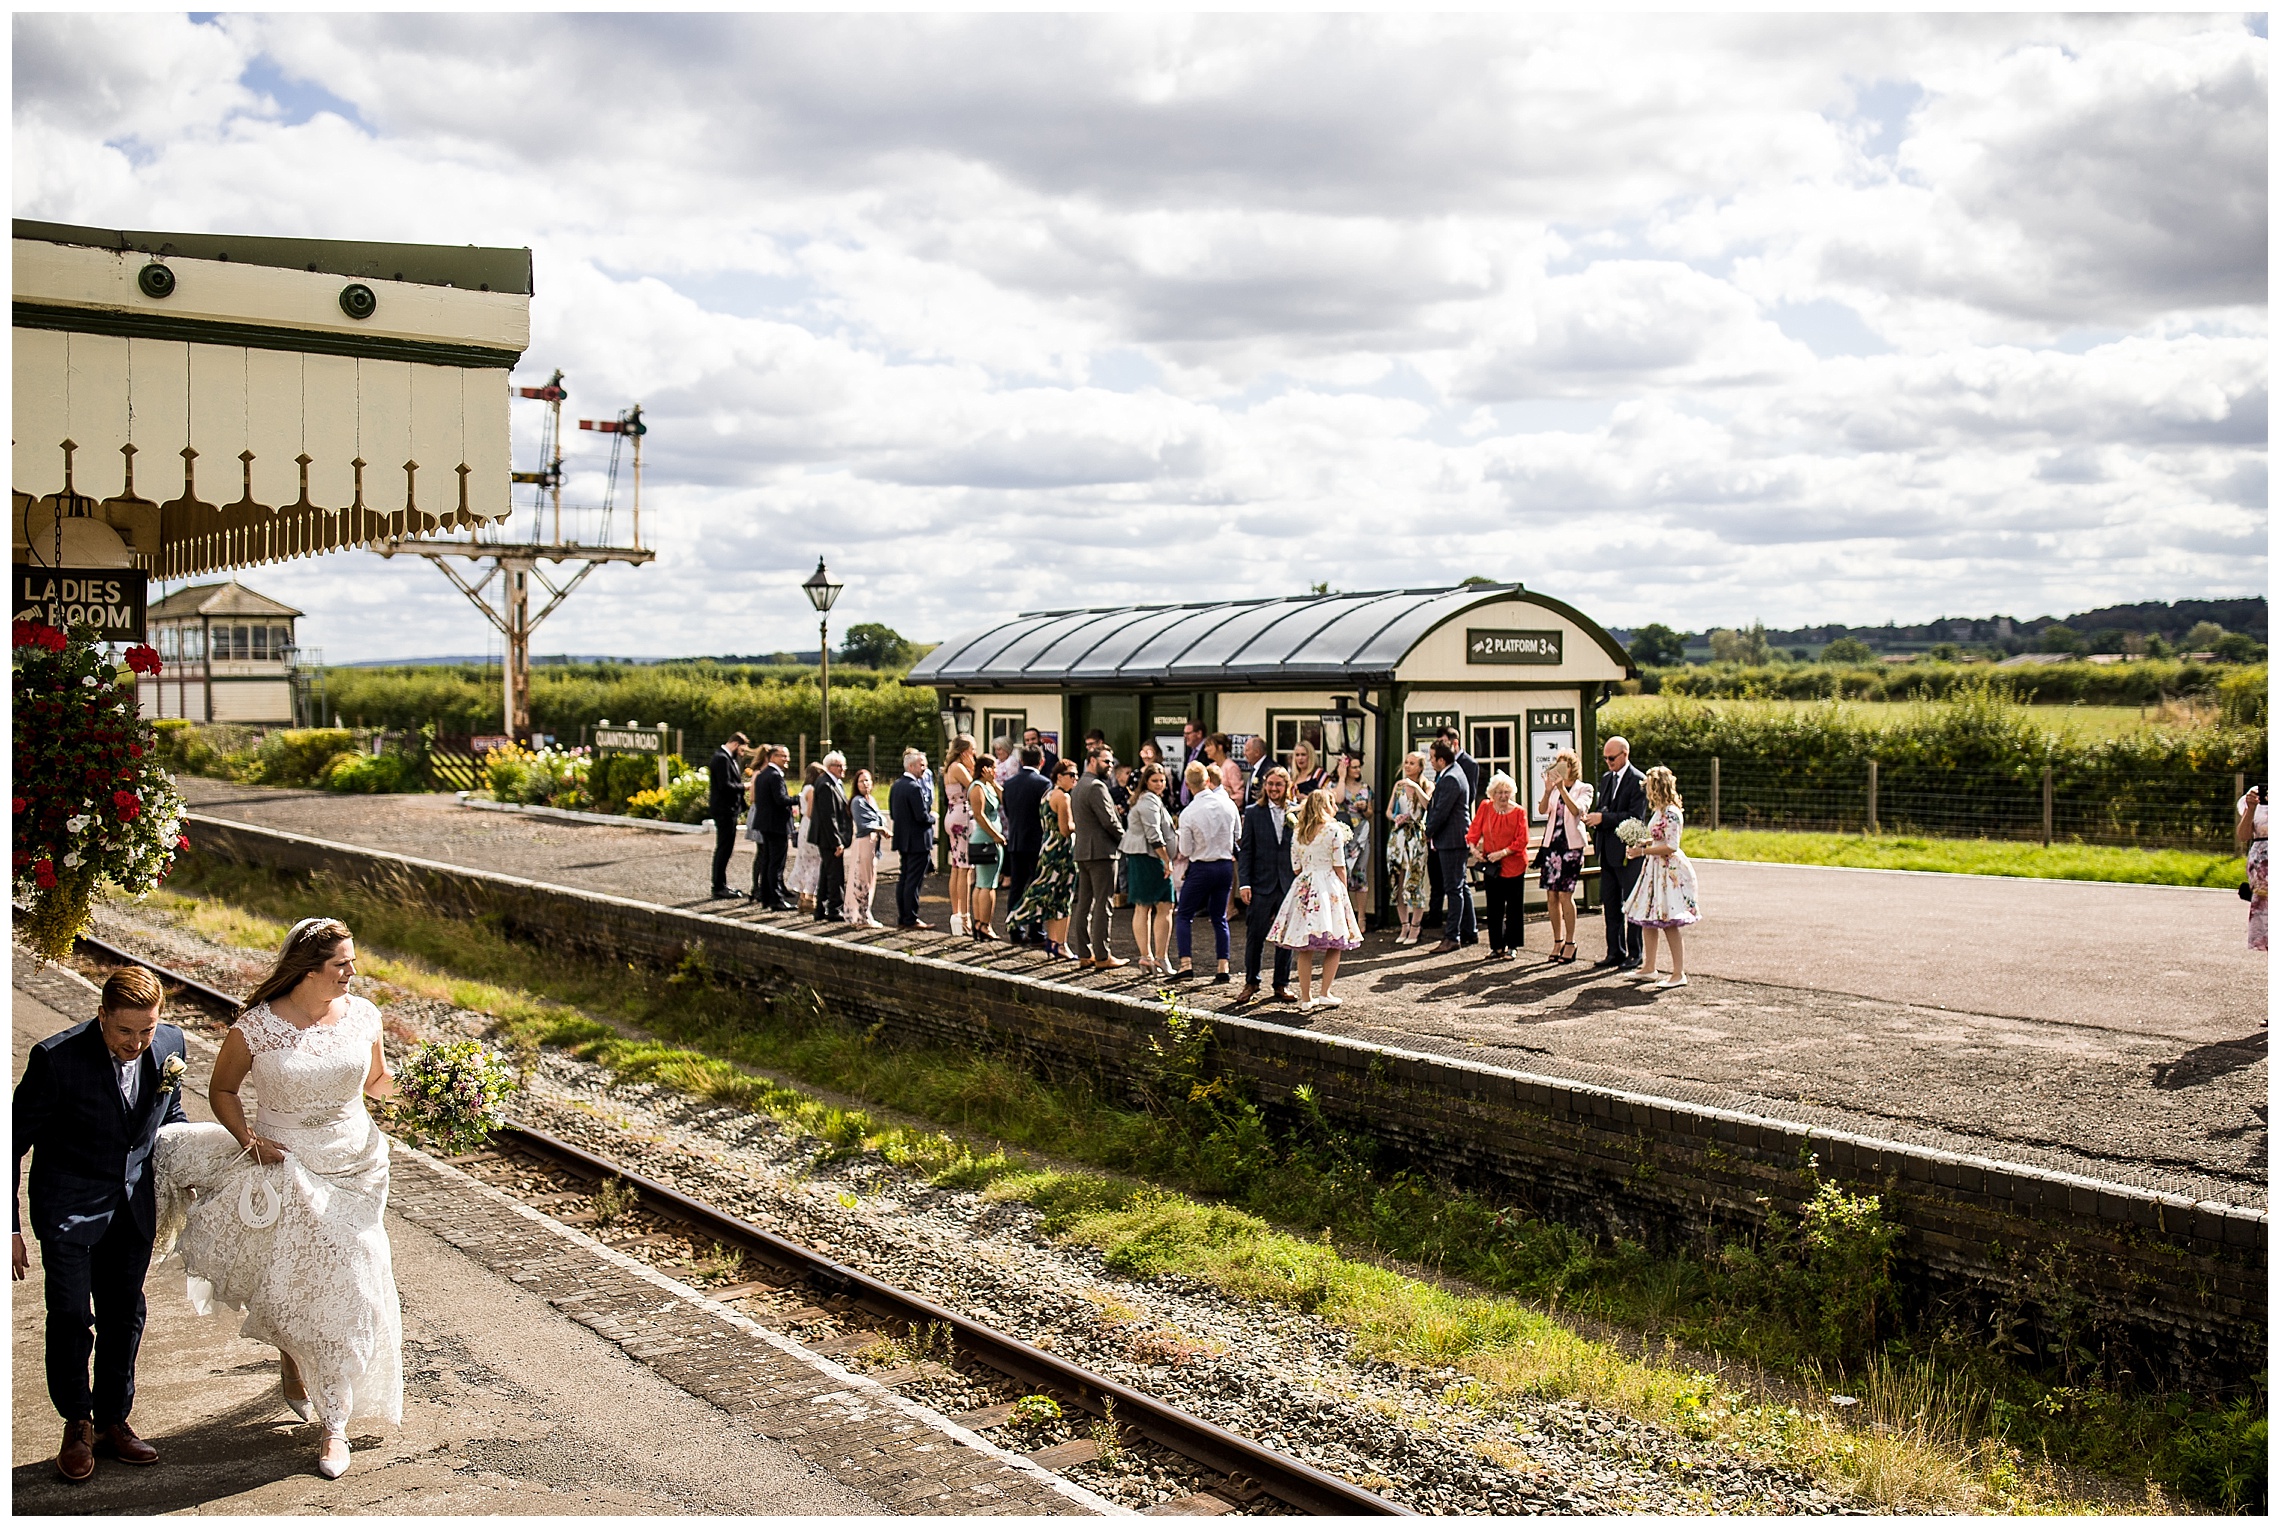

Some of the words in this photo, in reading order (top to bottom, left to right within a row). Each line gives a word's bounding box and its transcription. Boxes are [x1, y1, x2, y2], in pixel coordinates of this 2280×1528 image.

[24, 577, 121, 604] LADIES
[48, 603, 131, 629] ROOM
[1485, 637, 1493, 654] 2
[1494, 638, 1538, 653] PLATFORM
[1539, 638, 1547, 655] 3
[1416, 715, 1452, 728] LNER
[1534, 713, 1568, 725] LNER
[595, 730, 634, 749] QUAINTON
[635, 732, 660, 751] ROAD
